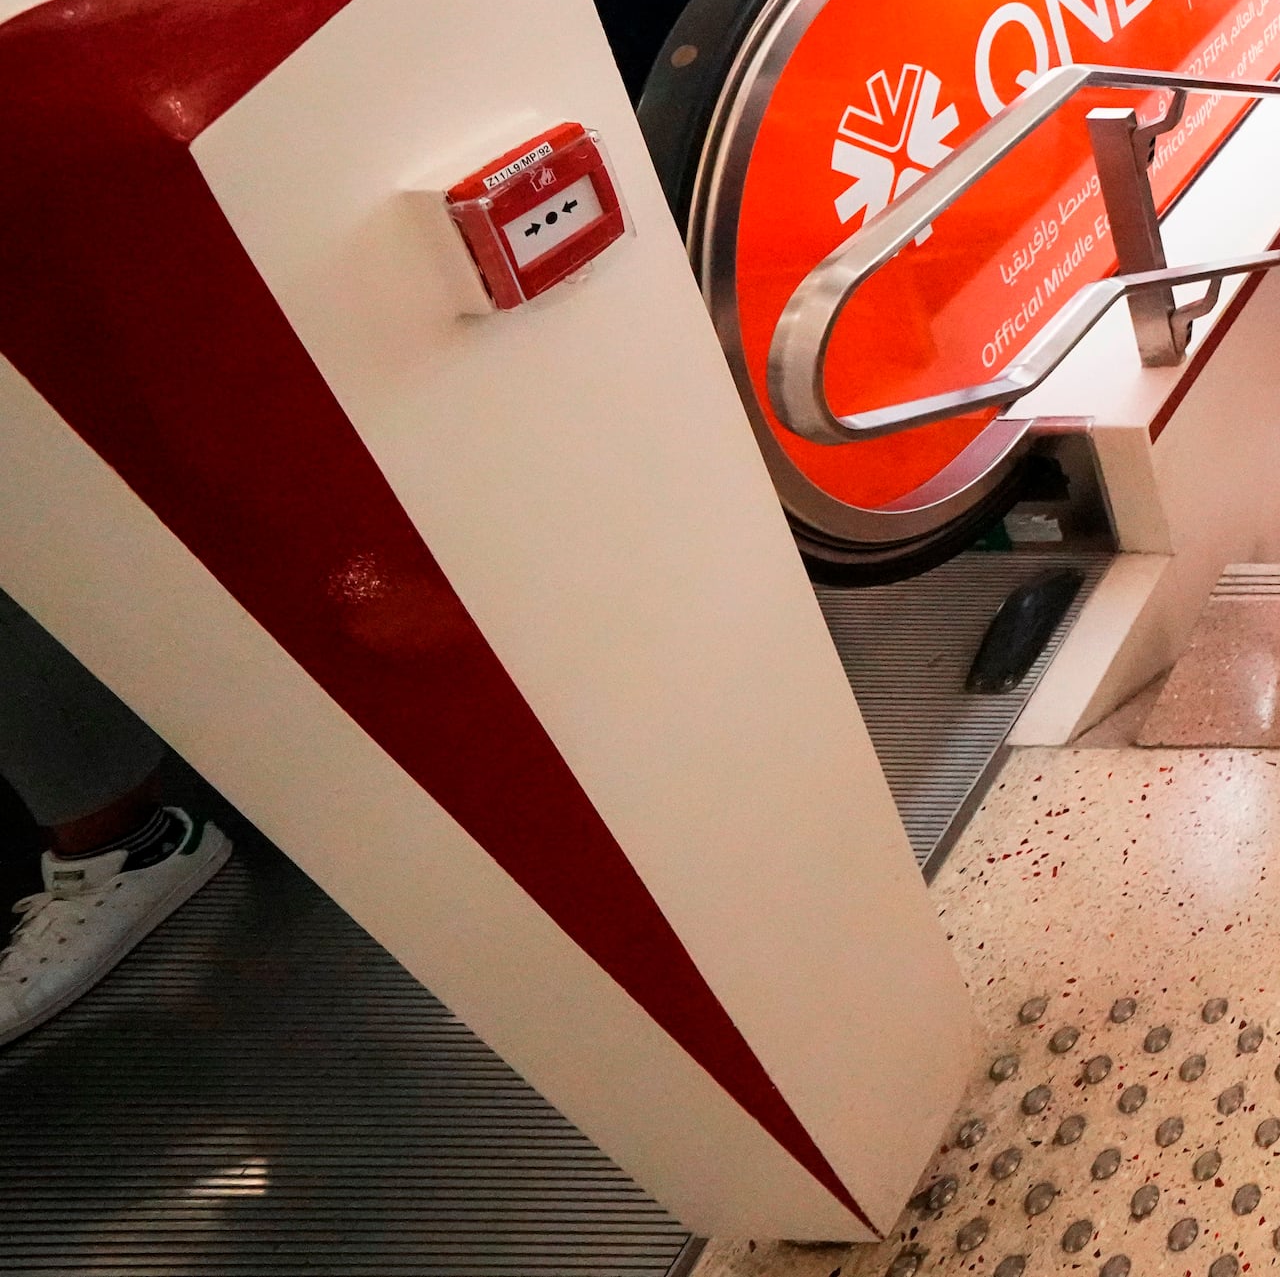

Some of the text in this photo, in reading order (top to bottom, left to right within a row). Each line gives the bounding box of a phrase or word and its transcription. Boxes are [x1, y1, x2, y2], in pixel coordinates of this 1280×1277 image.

[1203, 32, 1229, 68] FIFA
[486, 145, 550, 187] Z11/L9/MP/92
[982, 286, 1043, 368] Official
[1044, 236, 1094, 297] Middle
[1152, 133, 1185, 176] Africa
[1237, 52, 1247, 77] of
[1249, 39, 1264, 63] the
